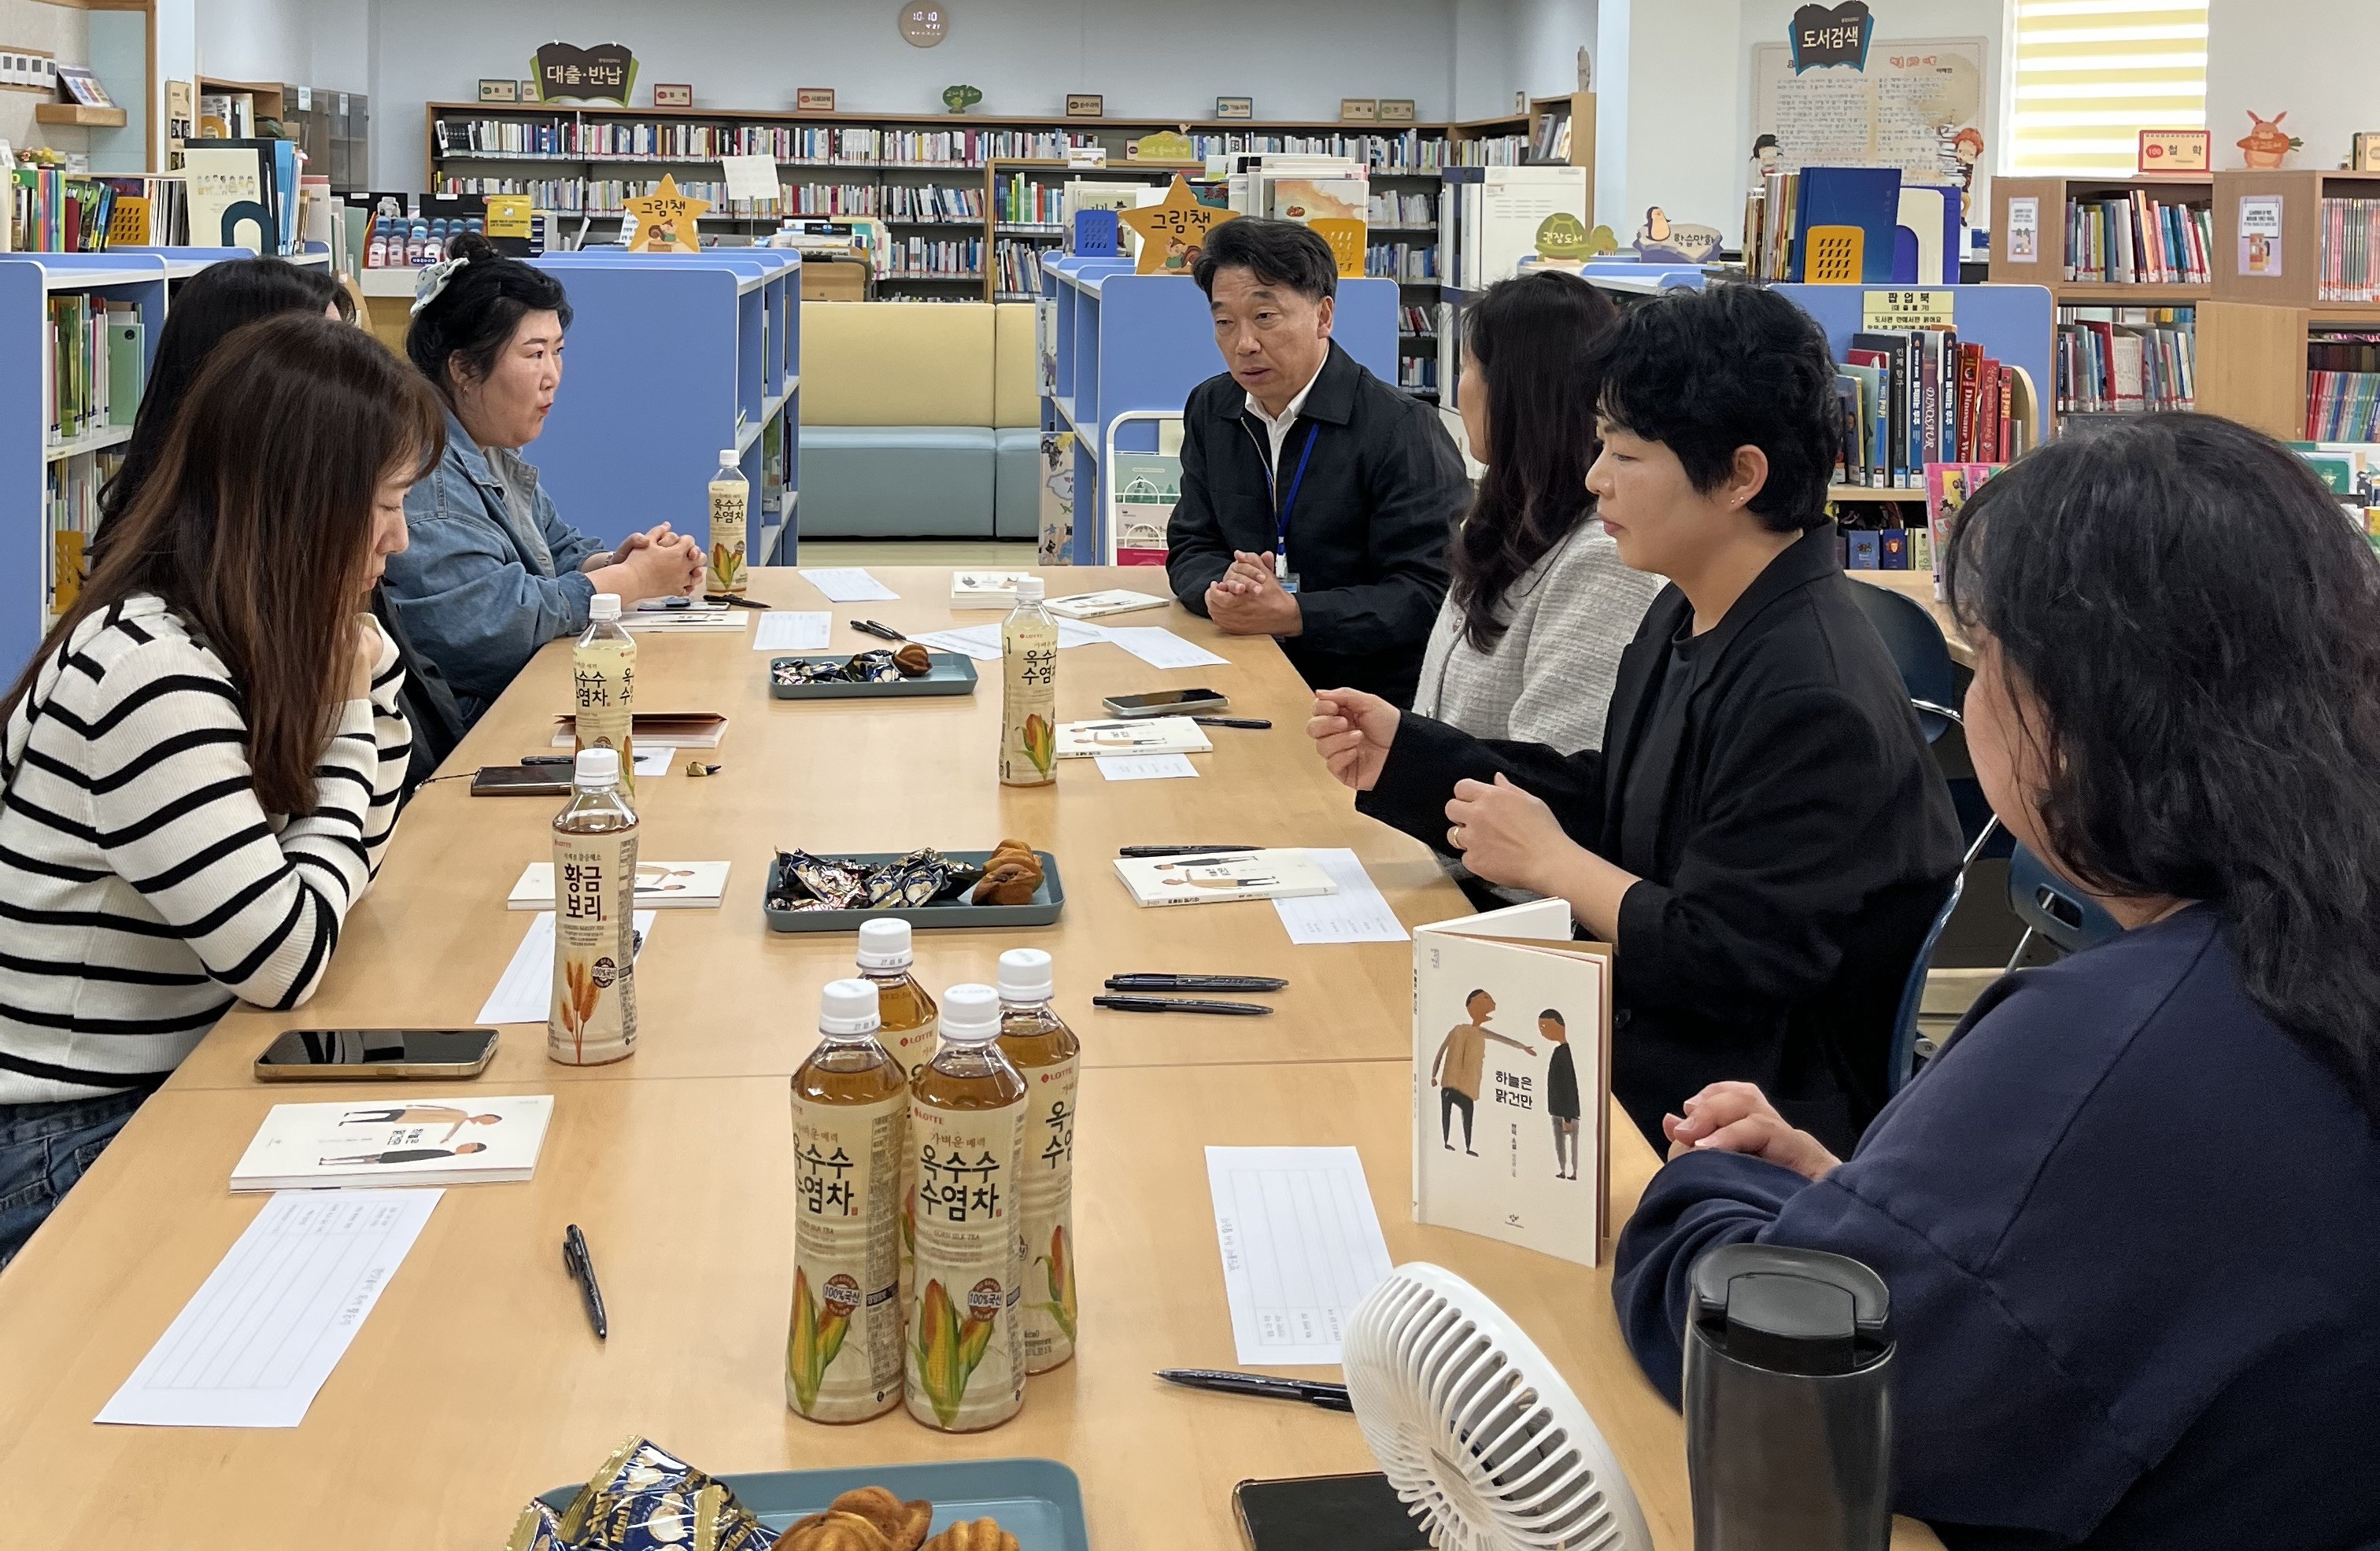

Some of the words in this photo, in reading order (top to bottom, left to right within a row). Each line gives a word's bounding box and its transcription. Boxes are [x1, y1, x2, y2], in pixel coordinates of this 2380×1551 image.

[1802, 26, 1859, 50] 도서검색
[640, 199, 686, 217] 그림책
[1150, 209, 1210, 234] 그림책
[1543, 230, 1584, 246] 권장도서
[1673, 232, 1715, 248] 학습만화
[1924, 386, 1936, 451] DINOSAUR
[714, 499, 745, 511] 옥수수
[714, 511, 745, 523] 수염차
[1023, 648, 1057, 667] 옥수
[574, 669, 607, 688] 수수
[1021, 665, 1056, 685] 수염
[576, 688, 608, 707] 염차
[564, 862, 602, 893] 황금
[565, 893, 601, 921] 보리
[910, 1029, 933, 1045] LOTTE
[1051, 1067, 1073, 1080] LOTTE
[1495, 1070, 1532, 1091] 하늘은
[1495, 1088, 1532, 1110] 맑건만
[919, 1110, 944, 1125] LOTTE
[931, 1132, 964, 1149] 가벼운
[920, 1144, 1000, 1184] 옥수수
[920, 1179, 1000, 1222] 수염차
[825, 1285, 860, 1305] 100%국산
[970, 1291, 1003, 1306] 100%국산
